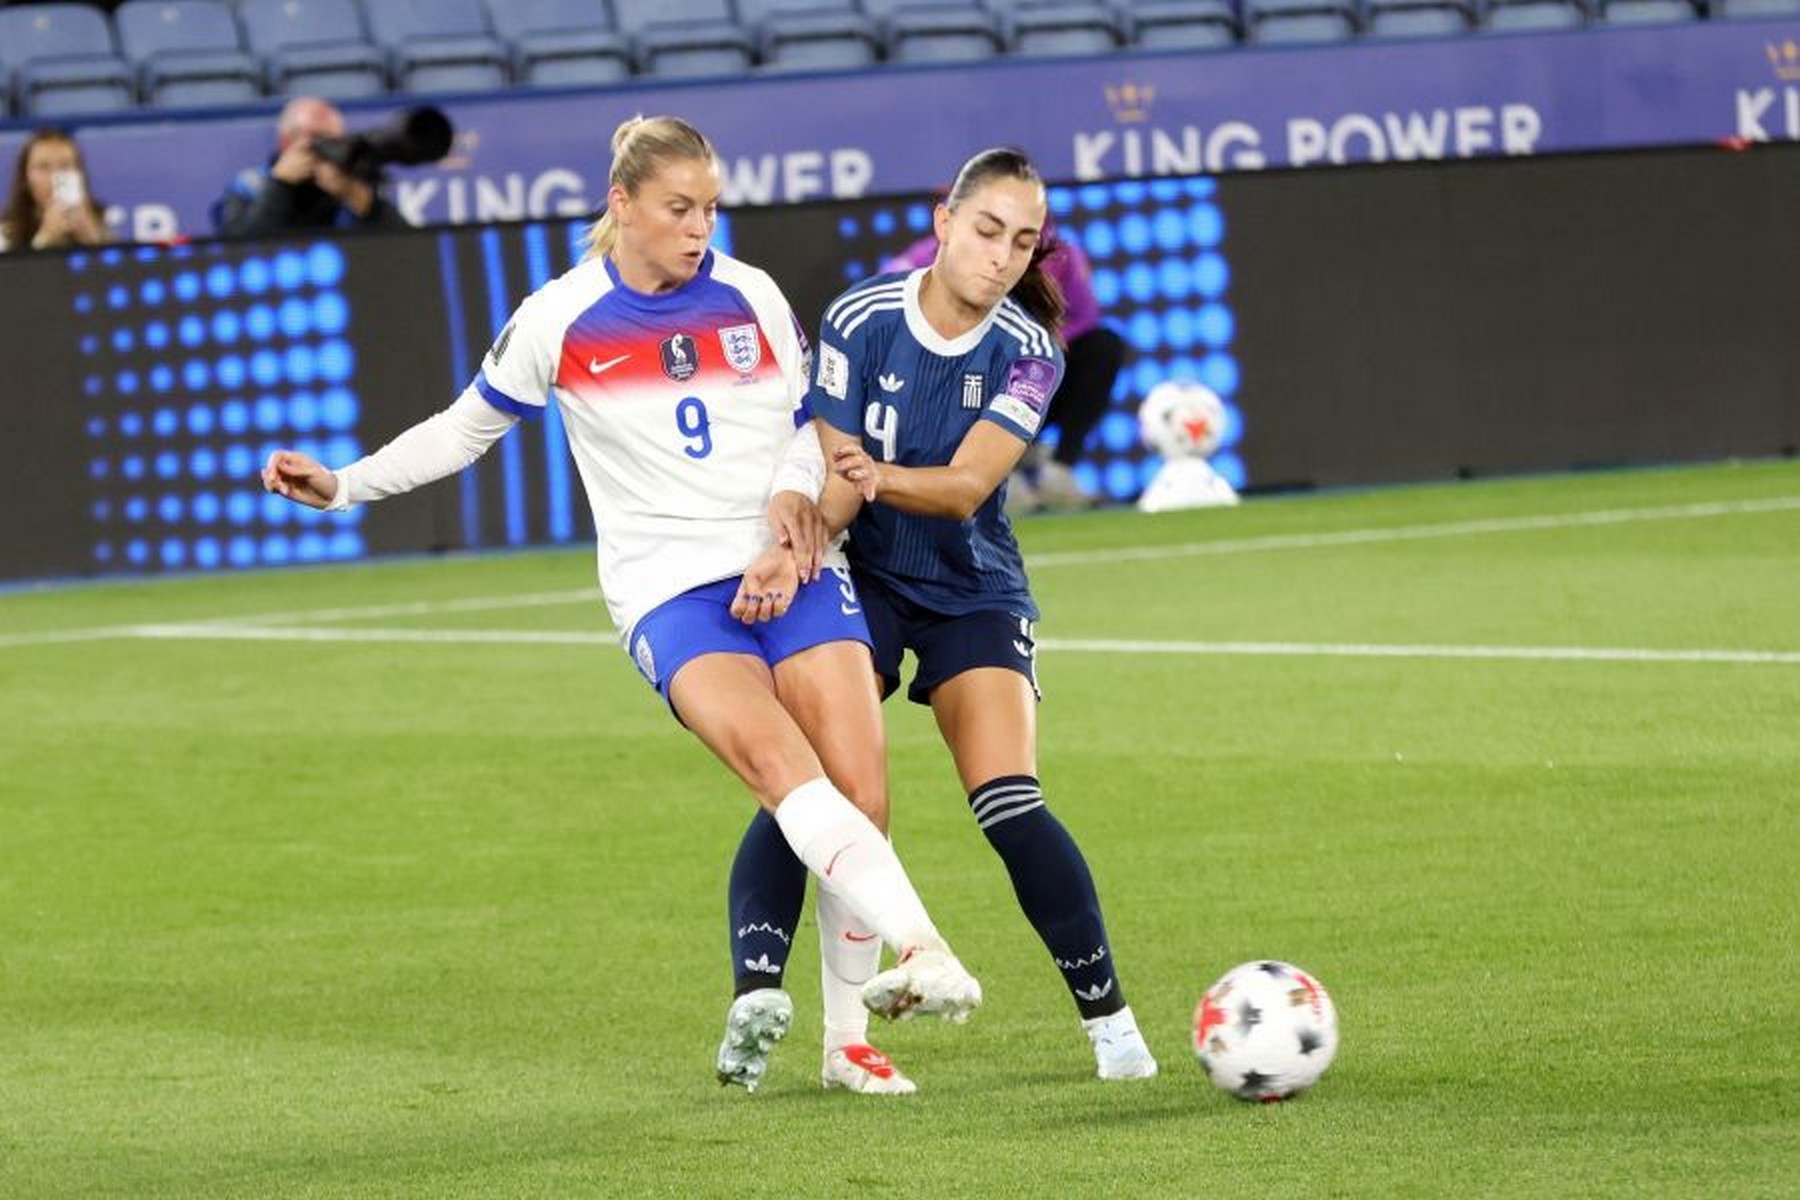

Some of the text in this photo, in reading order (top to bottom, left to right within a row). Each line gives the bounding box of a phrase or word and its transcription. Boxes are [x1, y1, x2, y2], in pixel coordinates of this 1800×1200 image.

[1073, 120, 1265, 182] KING
[675, 396, 712, 459] 9
[865, 401, 898, 462] 4
